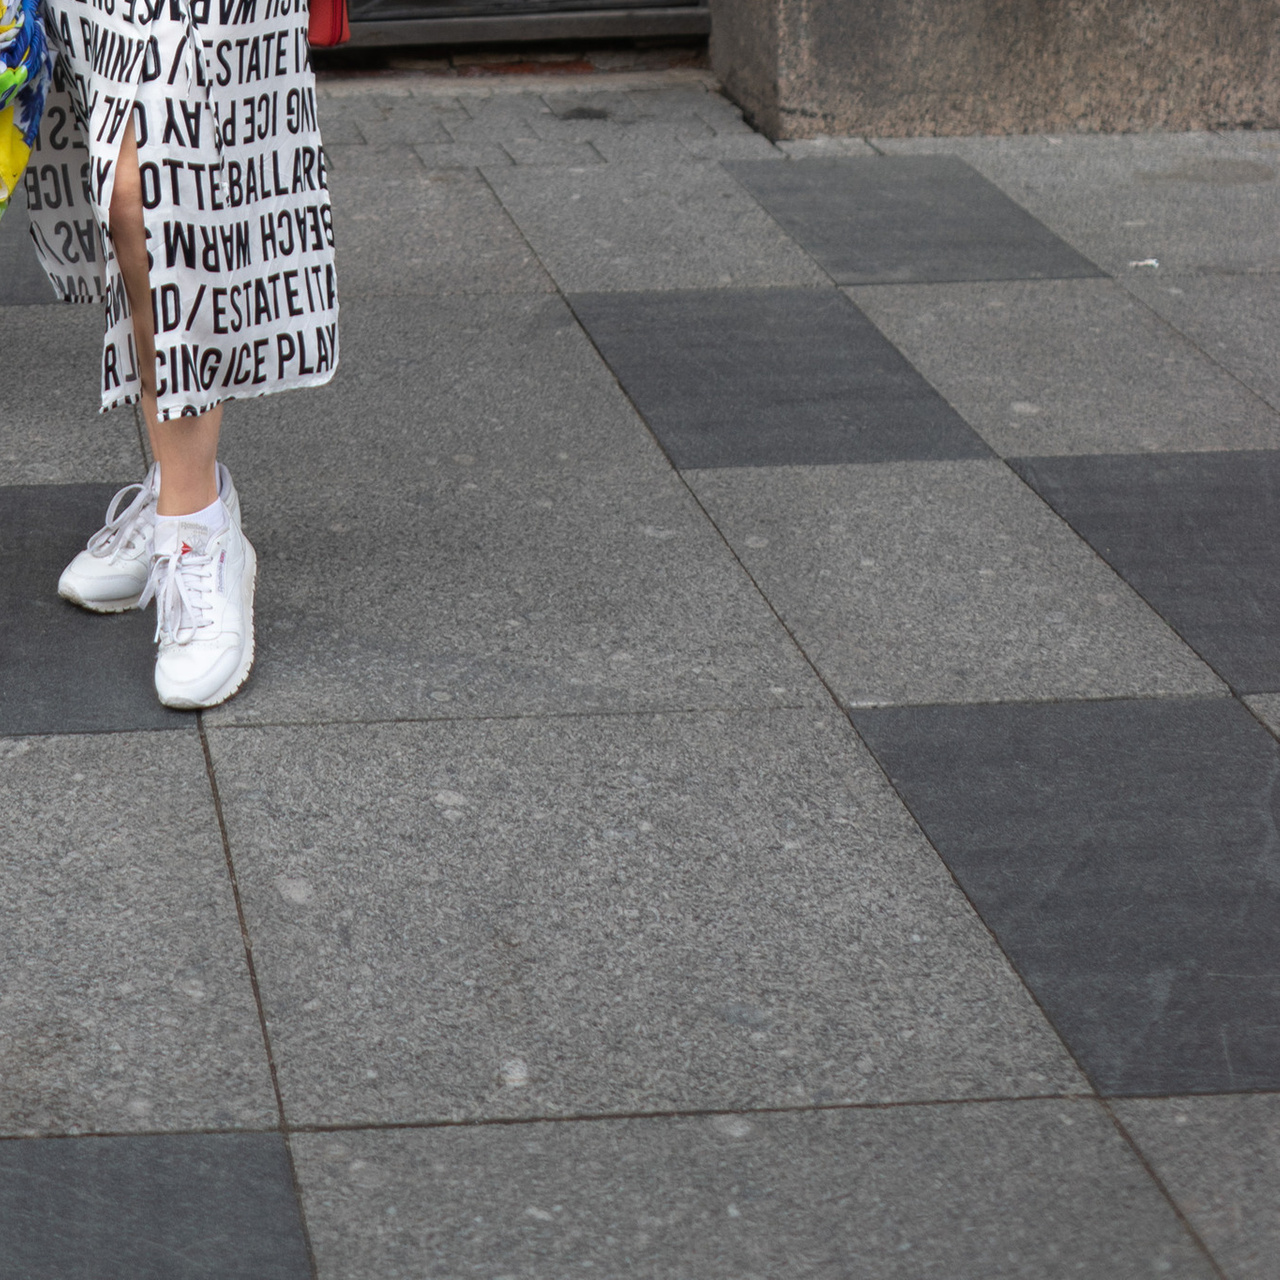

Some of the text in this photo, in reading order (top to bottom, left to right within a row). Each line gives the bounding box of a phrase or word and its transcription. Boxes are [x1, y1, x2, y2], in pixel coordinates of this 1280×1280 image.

[163, 219, 253, 274] WARM
[212, 268, 304, 335] ESTATE
[276, 322, 337, 380] PLAY
